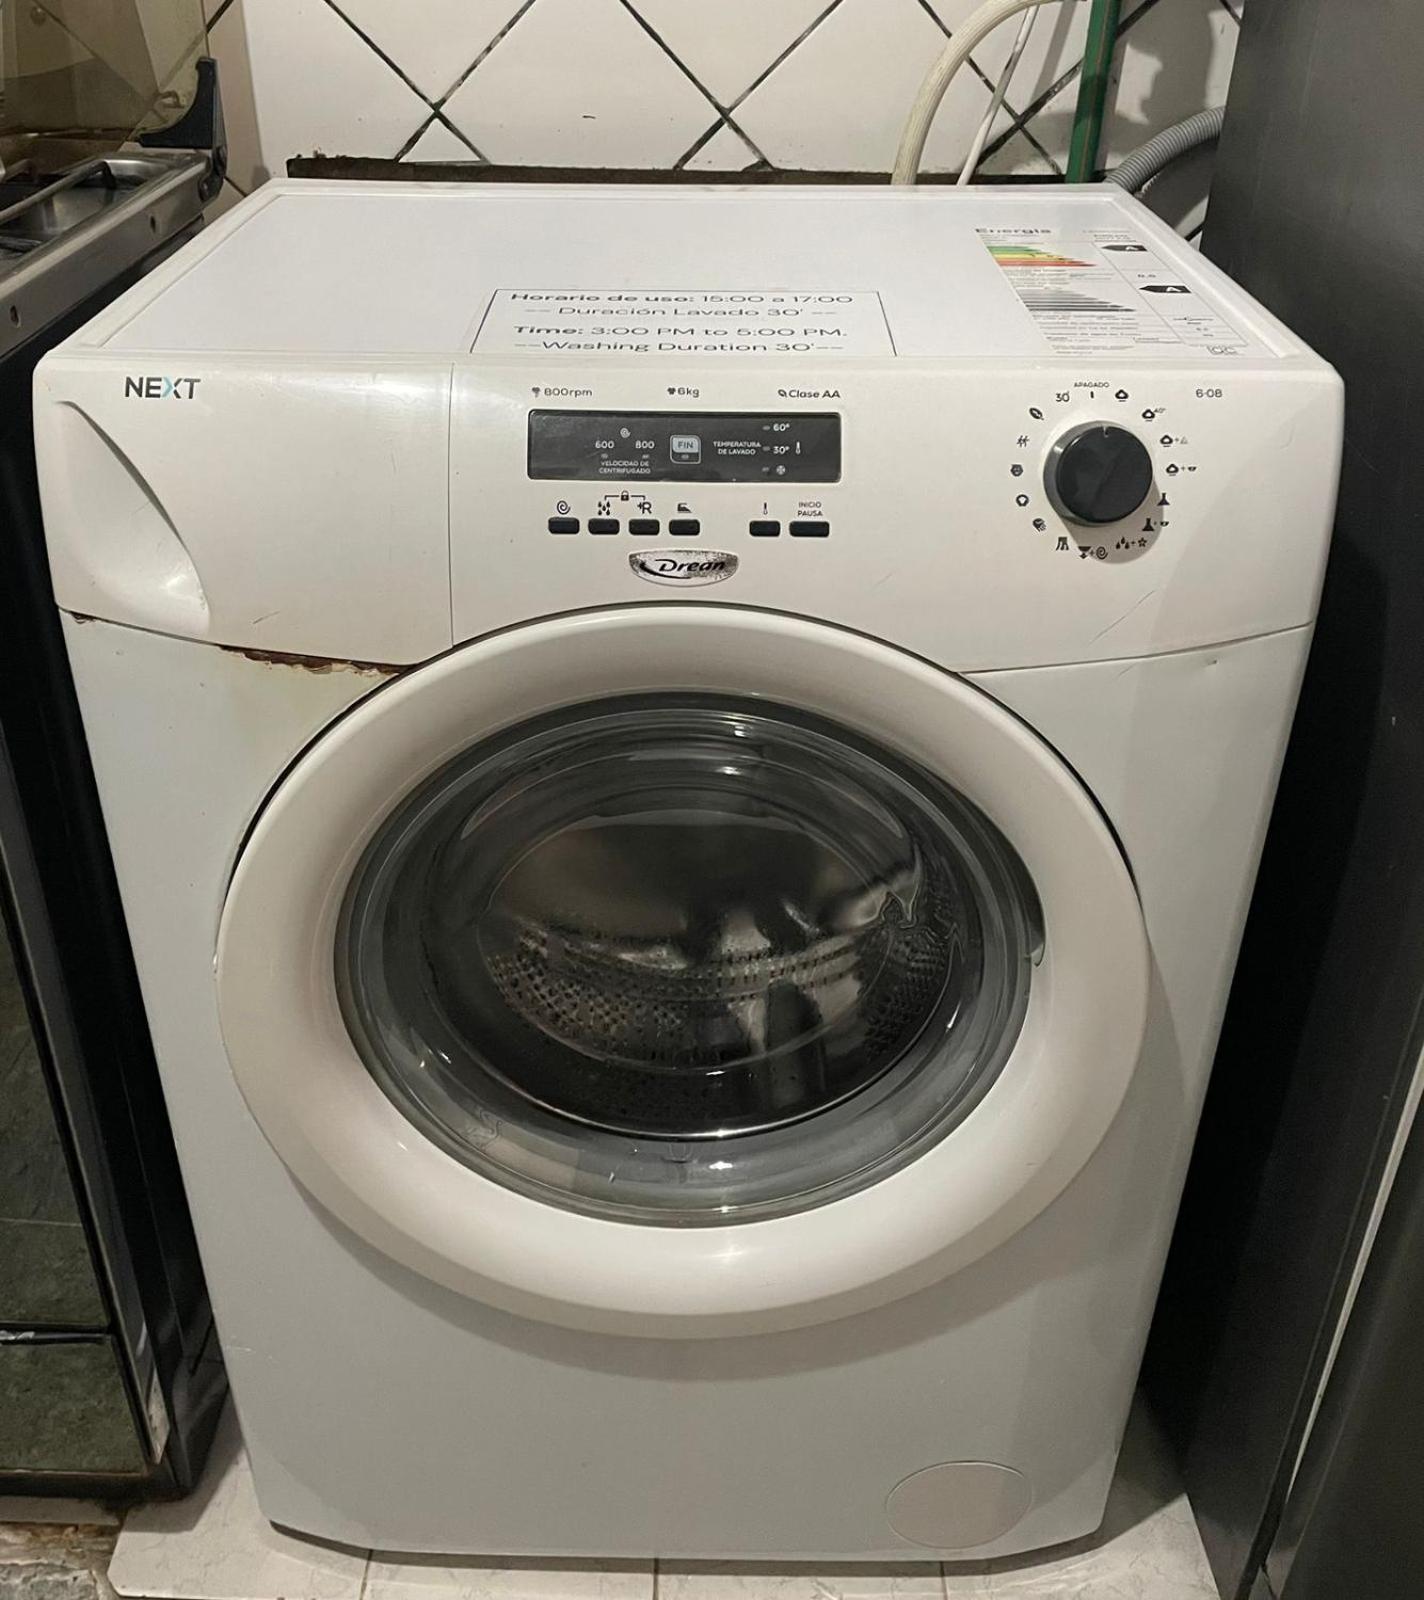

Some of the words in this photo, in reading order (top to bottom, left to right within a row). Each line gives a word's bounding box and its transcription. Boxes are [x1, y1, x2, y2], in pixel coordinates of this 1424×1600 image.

[511, 293, 600, 301] Horario
[794, 295, 853, 303] 17:00
[559, 306, 666, 315] Duración
[674, 308, 759, 316] Lavado
[768, 308, 803, 316] 30'
[513, 326, 583, 335] Time:
[591, 327, 649, 335] 3:00
[705, 328, 728, 336] to
[737, 328, 795, 336] 5:00
[803, 328, 848, 336] PM.
[658, 342, 767, 351] Duration
[124, 376, 201, 399] NEXT
[544, 387, 593, 398] 800rpm
[677, 386, 700, 398] 6kg
[788, 389, 820, 398] Clase
[822, 389, 841, 398] AA
[773, 423, 790, 432] 60°
[595, 440, 615, 449] 600
[635, 440, 655, 449] 800
[677, 441, 694, 449] FIN
[773, 445, 790, 455] 30°
[654, 558, 726, 572] Drean
